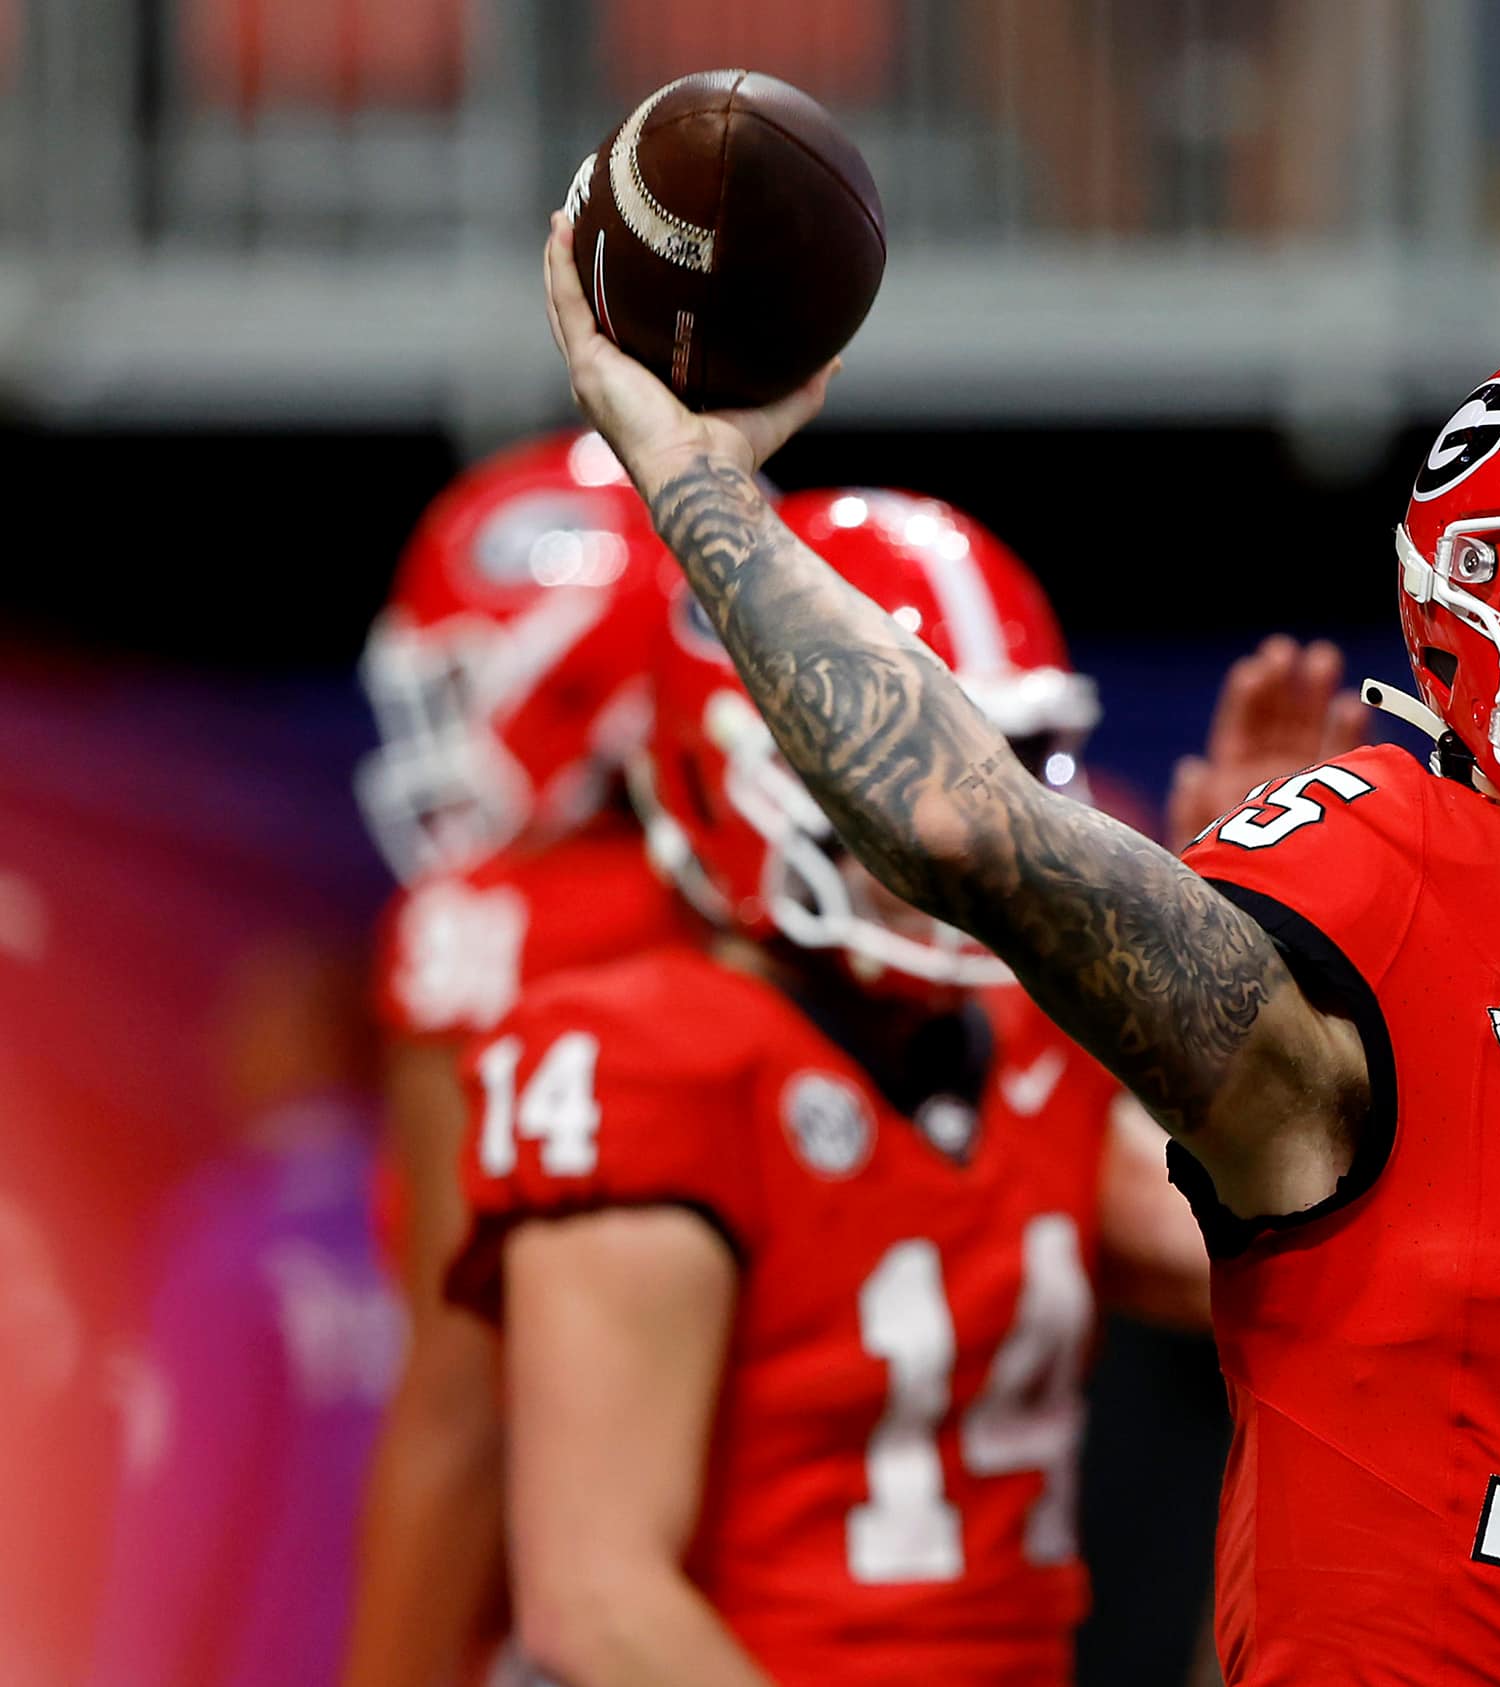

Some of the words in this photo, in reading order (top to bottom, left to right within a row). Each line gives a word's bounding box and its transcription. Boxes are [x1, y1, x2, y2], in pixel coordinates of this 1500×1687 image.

[1186, 763, 1376, 850] 5
[477, 1032, 601, 1177] 14
[846, 1213, 1092, 1586] 14
